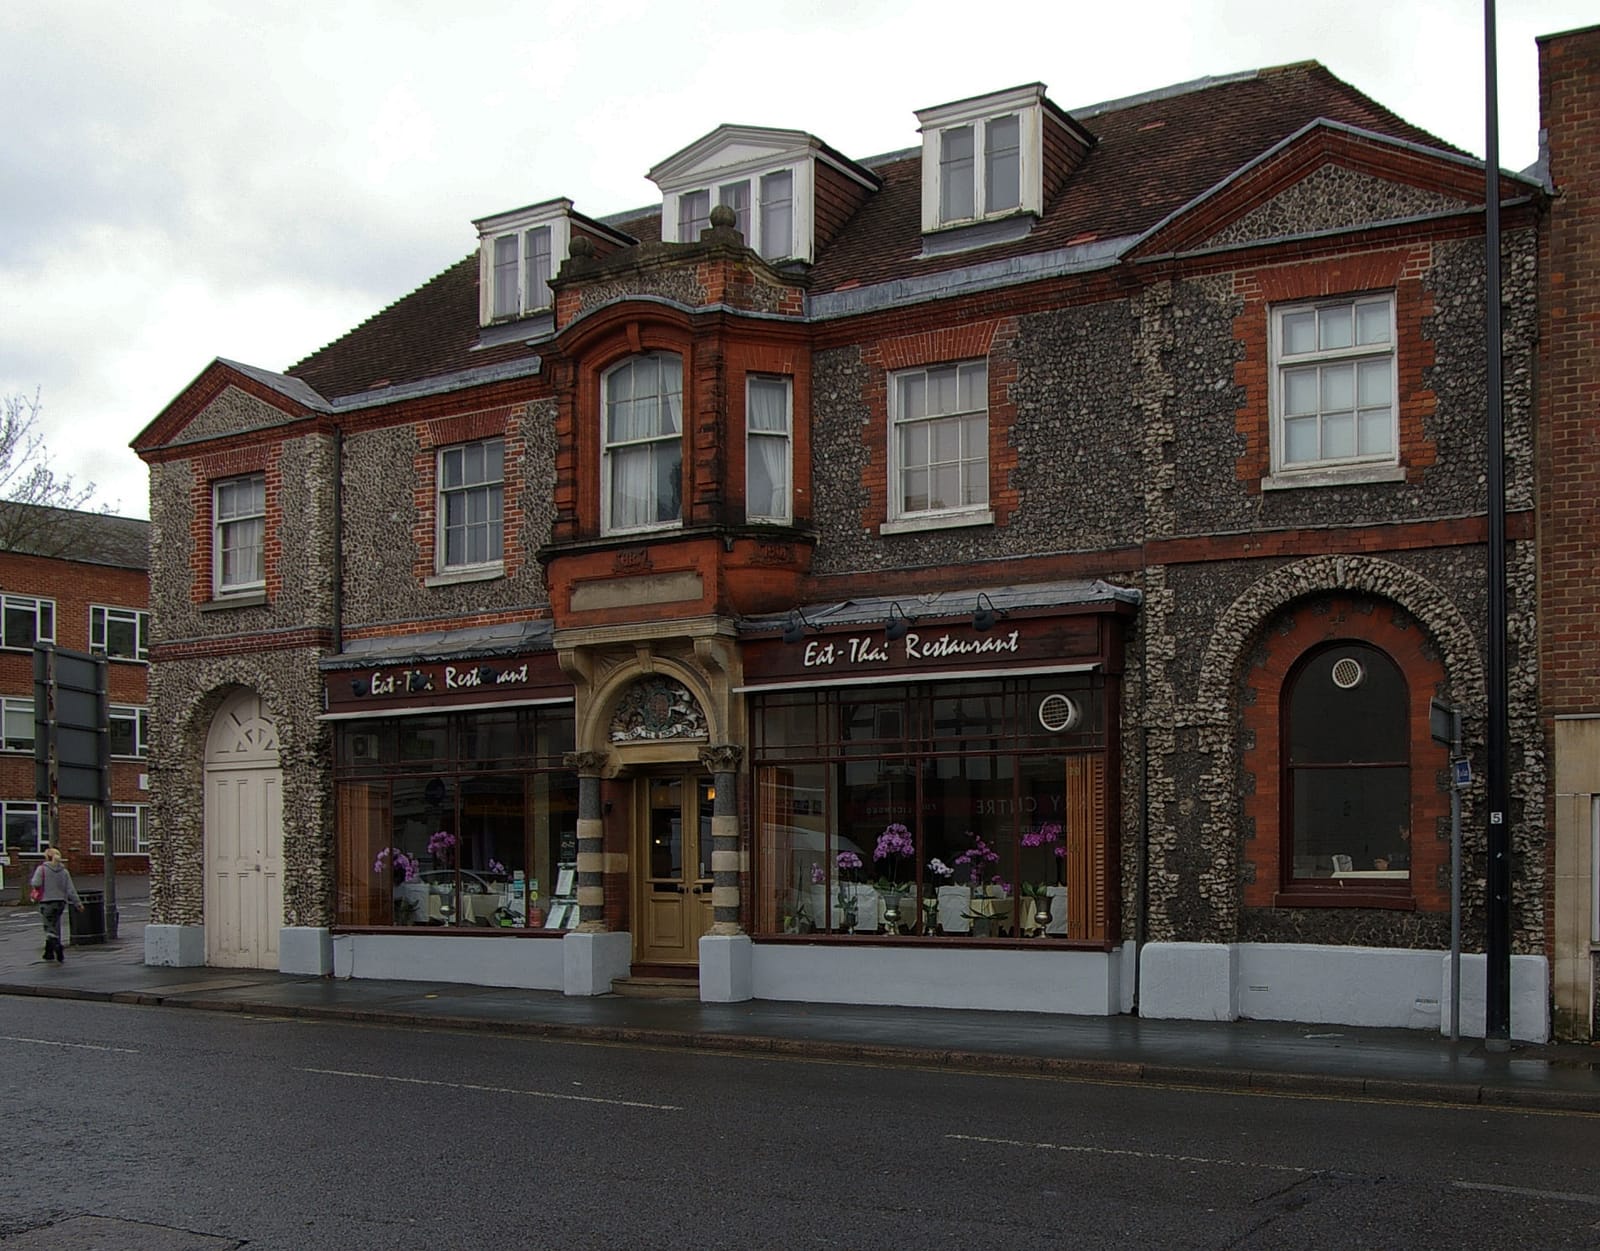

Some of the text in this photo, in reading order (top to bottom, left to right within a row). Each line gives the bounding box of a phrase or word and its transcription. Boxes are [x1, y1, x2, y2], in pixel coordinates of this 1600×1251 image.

[905, 630, 1019, 659] Restaurant
[371, 669, 433, 694] Eat-Ti
[1493, 813, 1501, 823] 5
